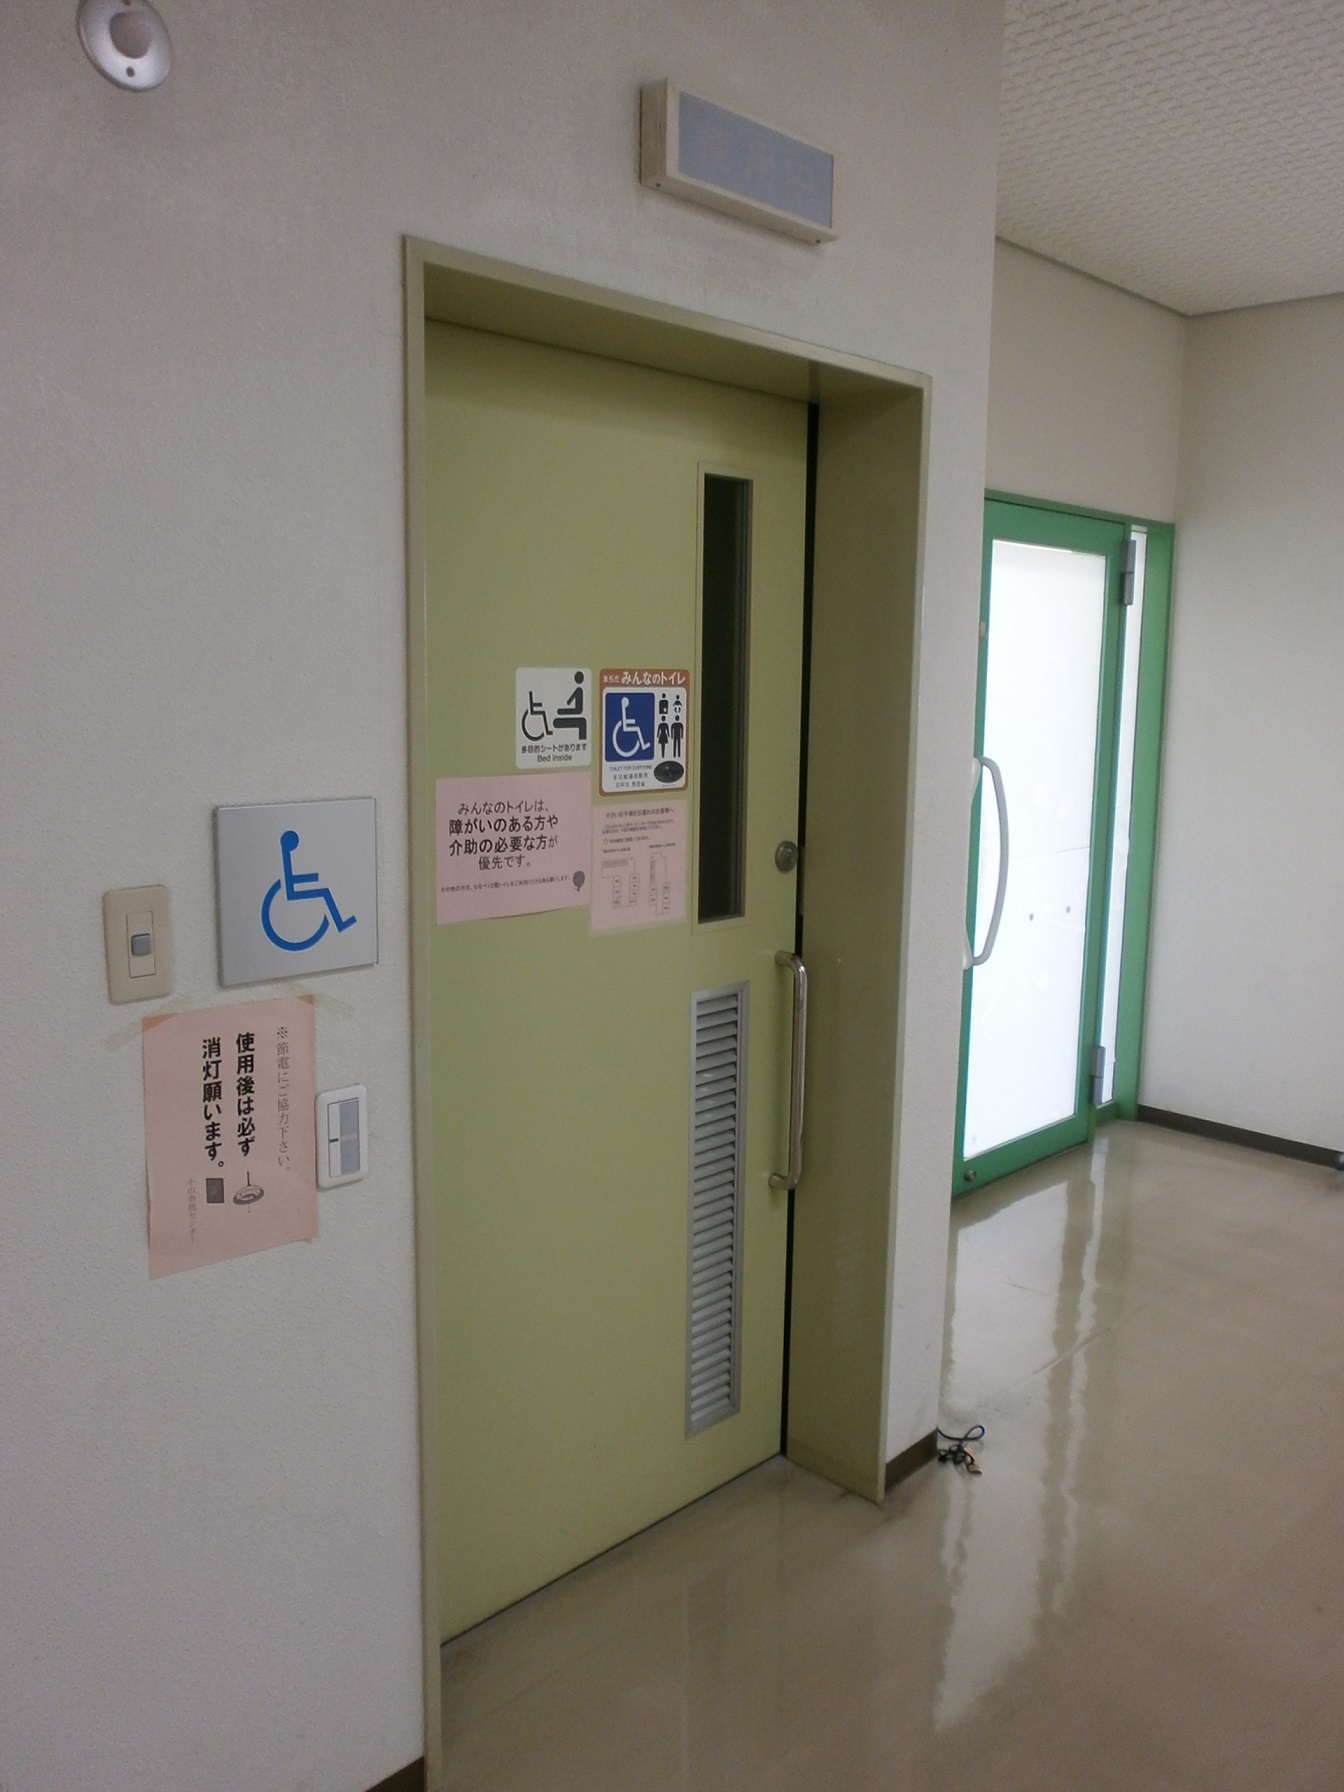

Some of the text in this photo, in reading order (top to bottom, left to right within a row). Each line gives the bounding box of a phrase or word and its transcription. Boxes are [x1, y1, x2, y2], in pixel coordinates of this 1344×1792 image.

[621, 671, 686, 685] みんなのトイレ
[521, 744, 587, 754] 多目的シートがあります
[457, 799, 549, 815] みんなのトイレは、
[449, 814, 558, 836] 障がいのある方や
[449, 834, 558, 857] 介助の必要な方が
[478, 853, 531, 871] 優先です。
[202, 1037, 224, 1168] 消灯願います。
[236, 1032, 255, 1157] 使用後は必ず
[276, 1026, 291, 1171] ※節電にご協力下さい。
